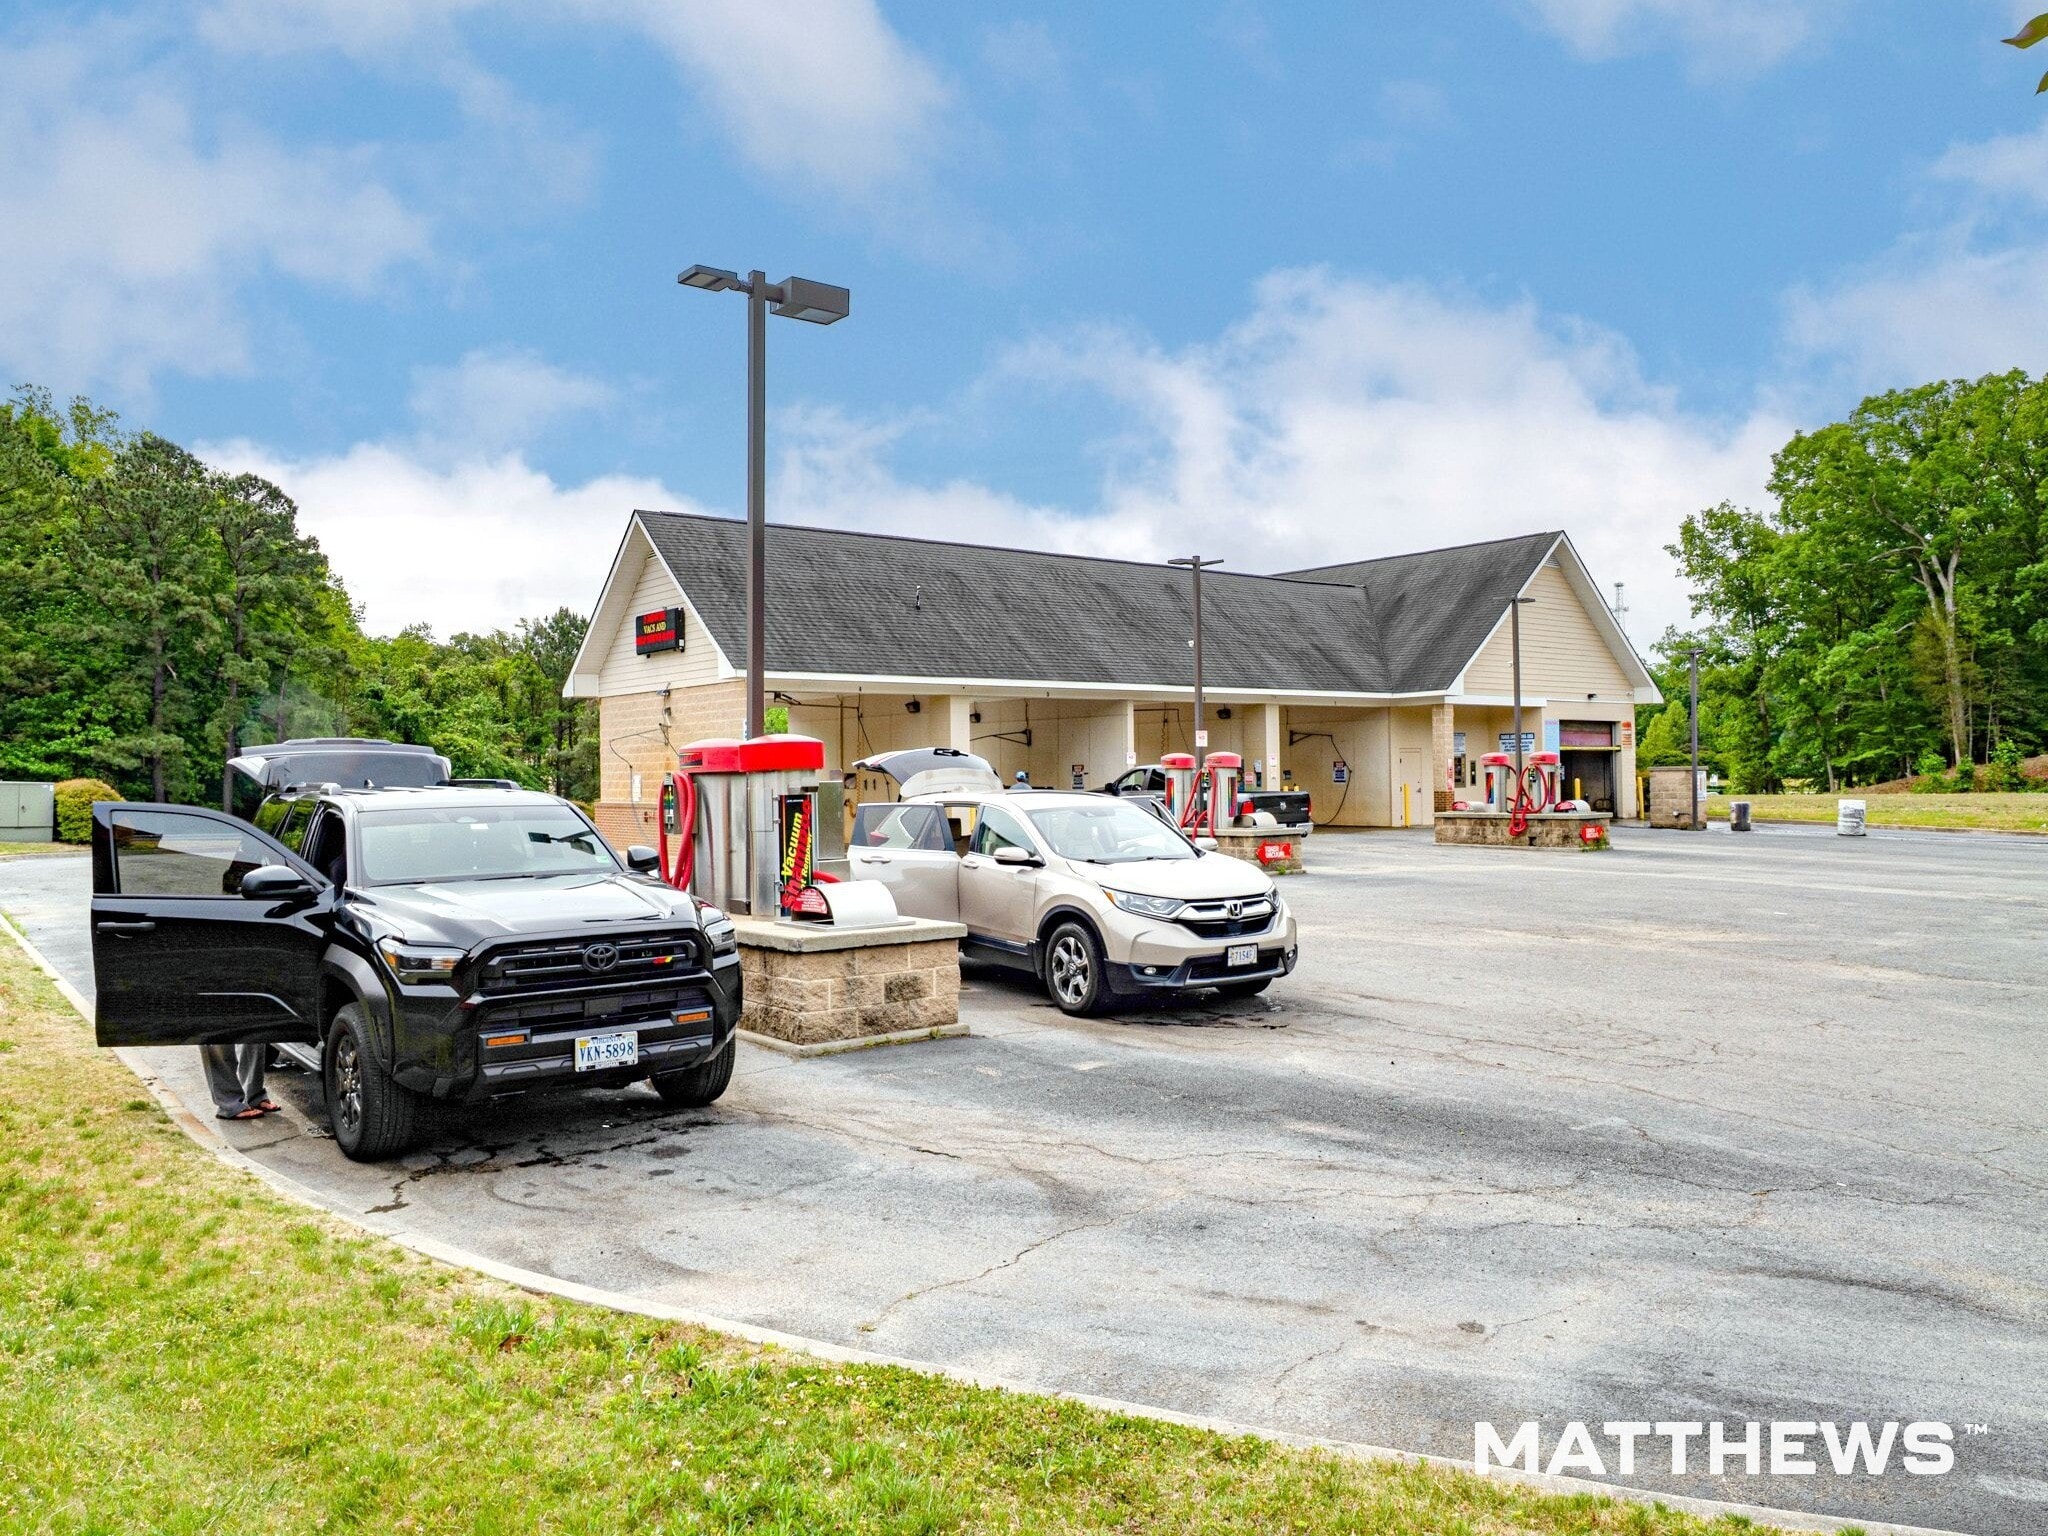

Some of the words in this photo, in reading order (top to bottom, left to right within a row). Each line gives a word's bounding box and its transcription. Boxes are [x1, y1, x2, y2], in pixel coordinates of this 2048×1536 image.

[656, 621, 667, 632] AND
[781, 812, 802, 877] Vacuum
[579, 1041, 634, 1062] VKN-5898
